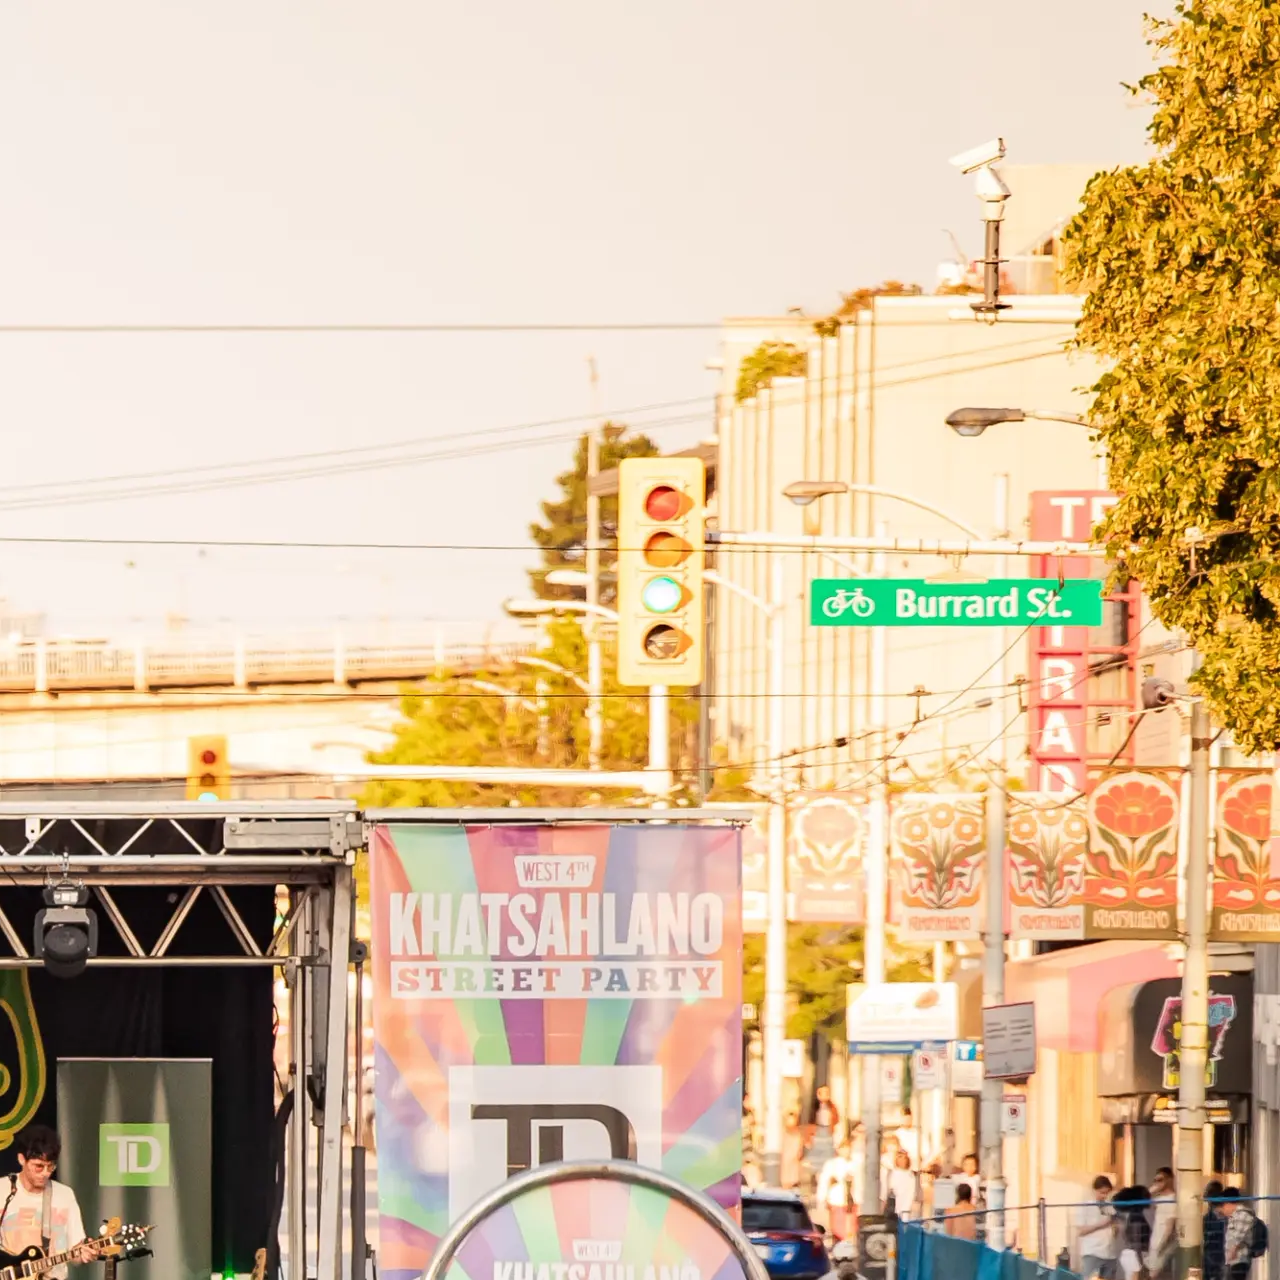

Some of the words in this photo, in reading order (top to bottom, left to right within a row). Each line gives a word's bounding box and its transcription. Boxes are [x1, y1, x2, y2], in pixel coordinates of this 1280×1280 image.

[895, 587, 1019, 618] Burrard
[1026, 588, 1072, 618] St.
[522, 861, 560, 882] WEST
[566, 861, 590, 882] 4TH
[390, 892, 723, 956] KHATSAHLANO
[397, 967, 561, 992] STREET
[582, 966, 717, 992] PARTY
[106, 1135, 163, 1174] TD
[470, 1103, 639, 1177] TD
